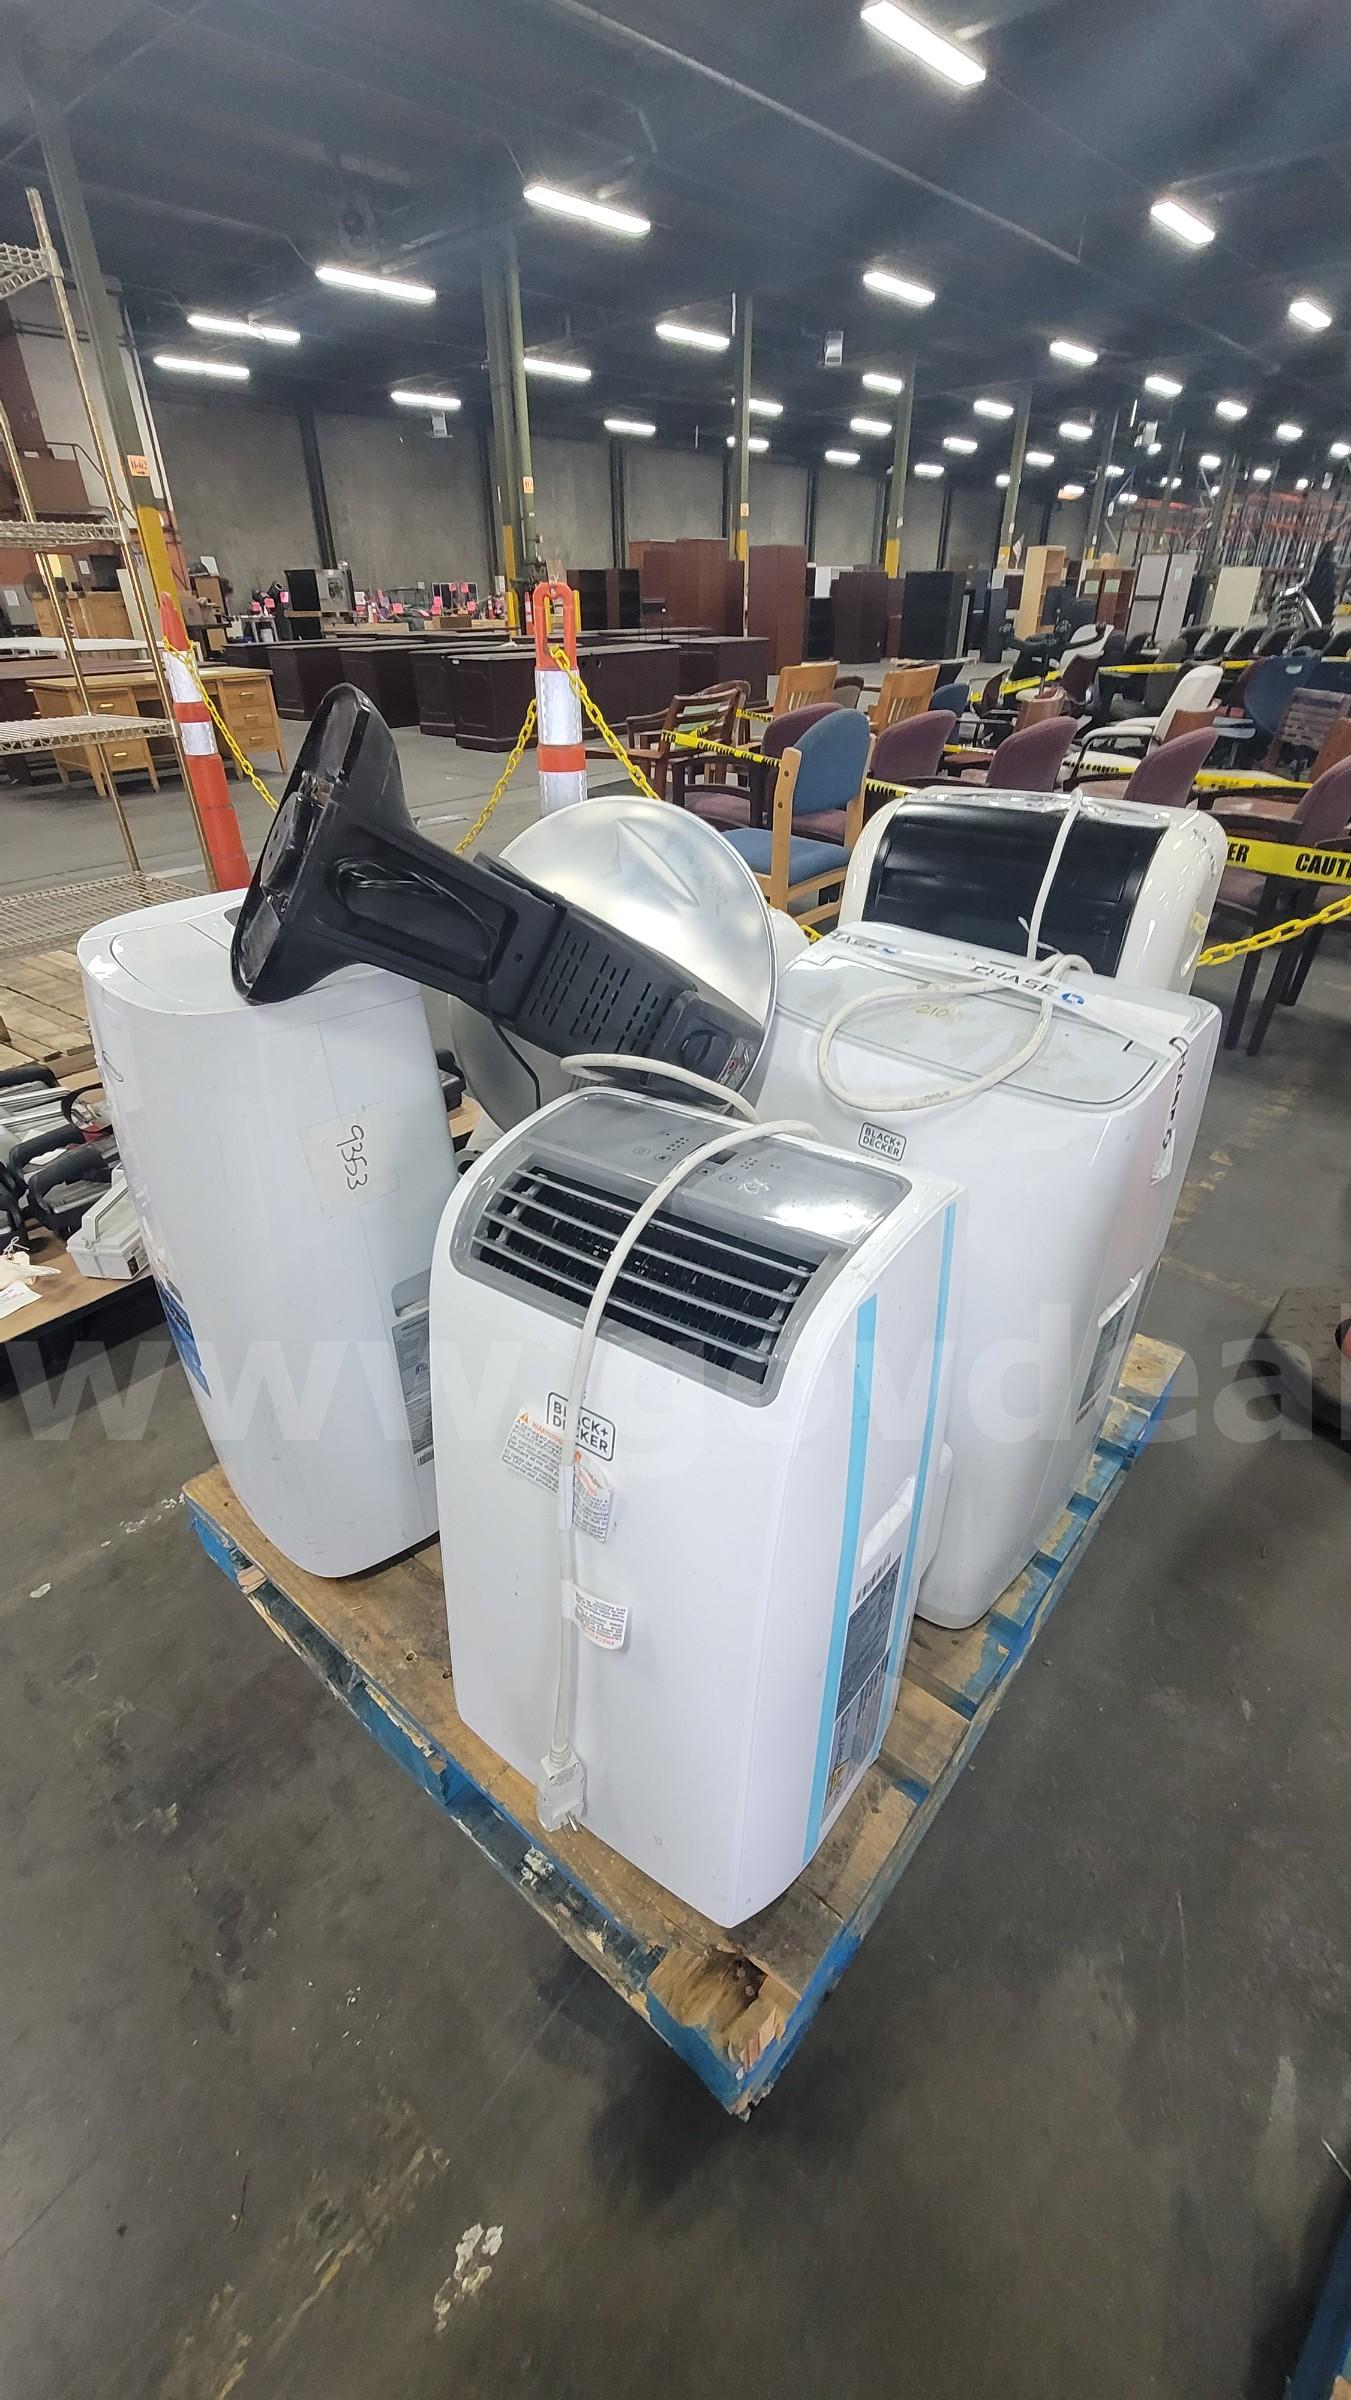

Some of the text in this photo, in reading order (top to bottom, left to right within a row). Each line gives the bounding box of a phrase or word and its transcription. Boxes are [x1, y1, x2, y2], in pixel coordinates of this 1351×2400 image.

[1227, 841, 1250, 863] ER
[914, 1003, 951, 1018] 210
[336, 1124, 368, 1190] 9353
[862, 1136, 900, 1156] DECKER
[553, 1401, 609, 1438] BLCK+
